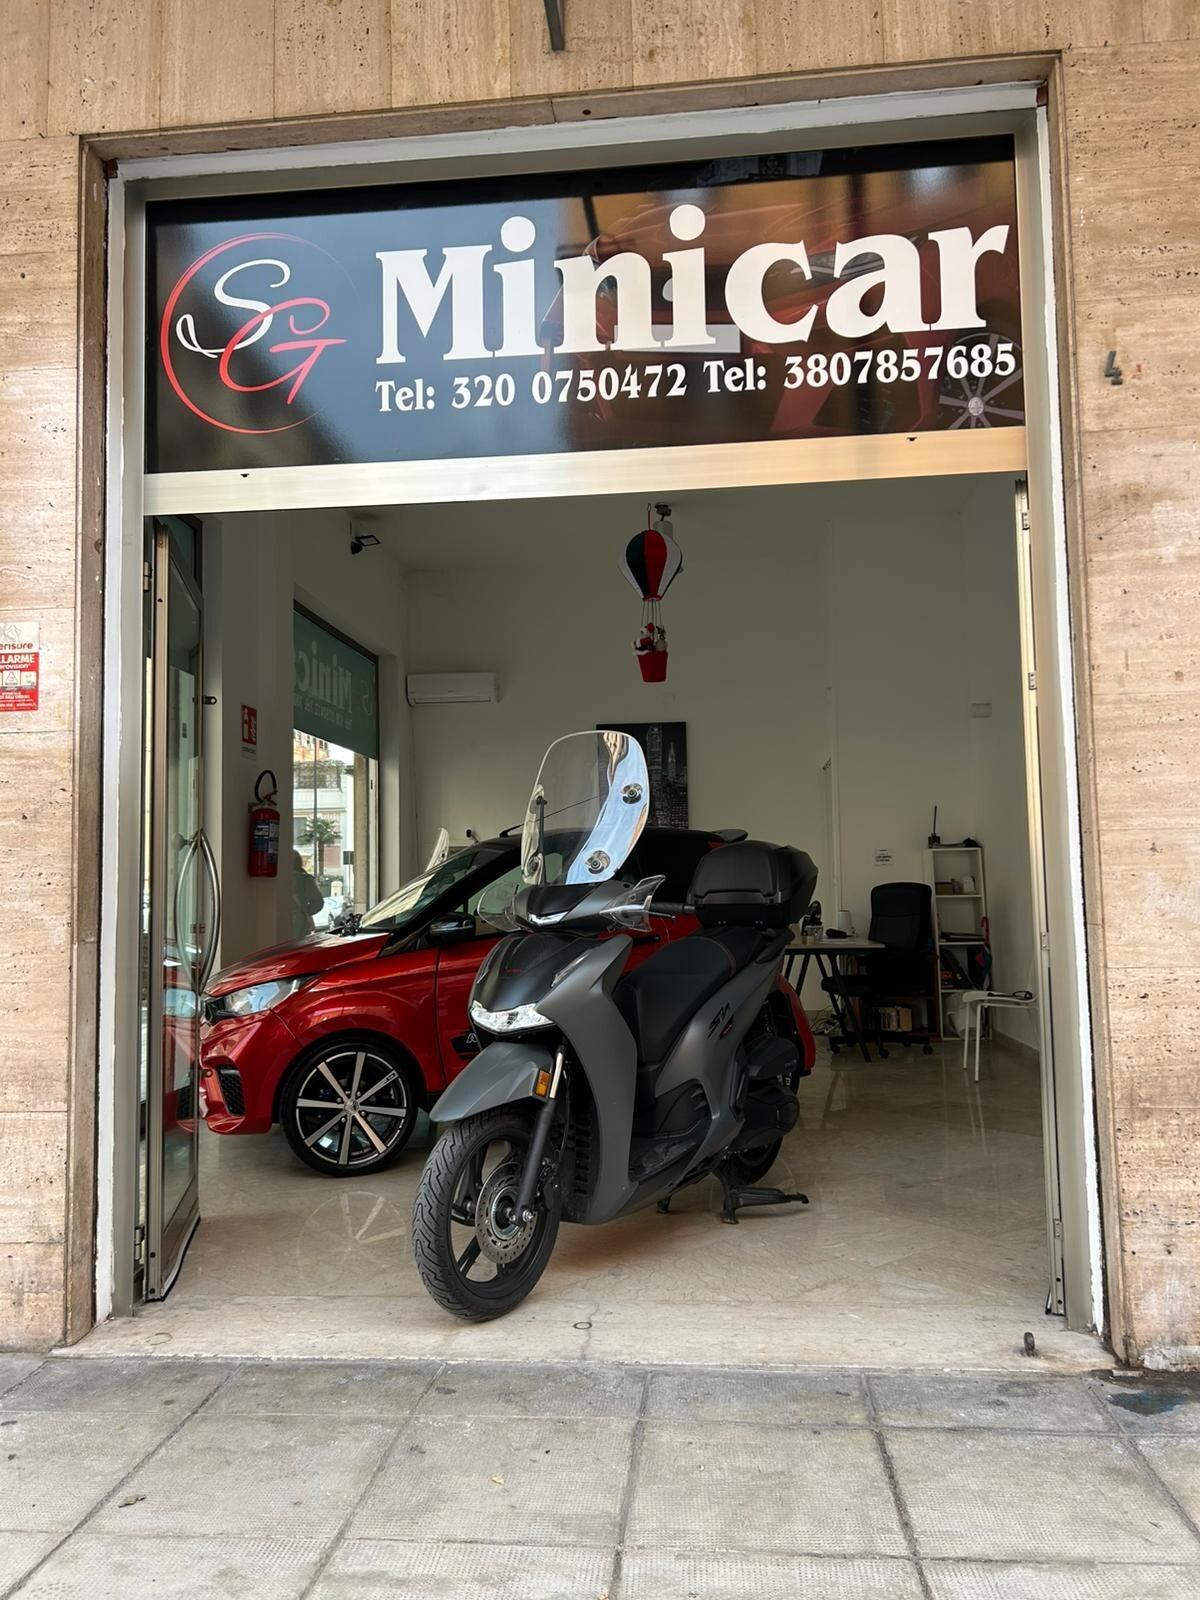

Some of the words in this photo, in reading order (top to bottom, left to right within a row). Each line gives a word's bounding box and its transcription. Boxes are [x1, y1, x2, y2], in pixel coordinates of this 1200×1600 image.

[375, 203, 1010, 365] Minicar
[375, 379, 435, 412] Tel:
[451, 374, 516, 409] 320
[531, 363, 687, 405] 0750472
[703, 358, 767, 393] Tel:
[783, 343, 1016, 390] 3807857685
[1104, 350, 1124, 385] 4
